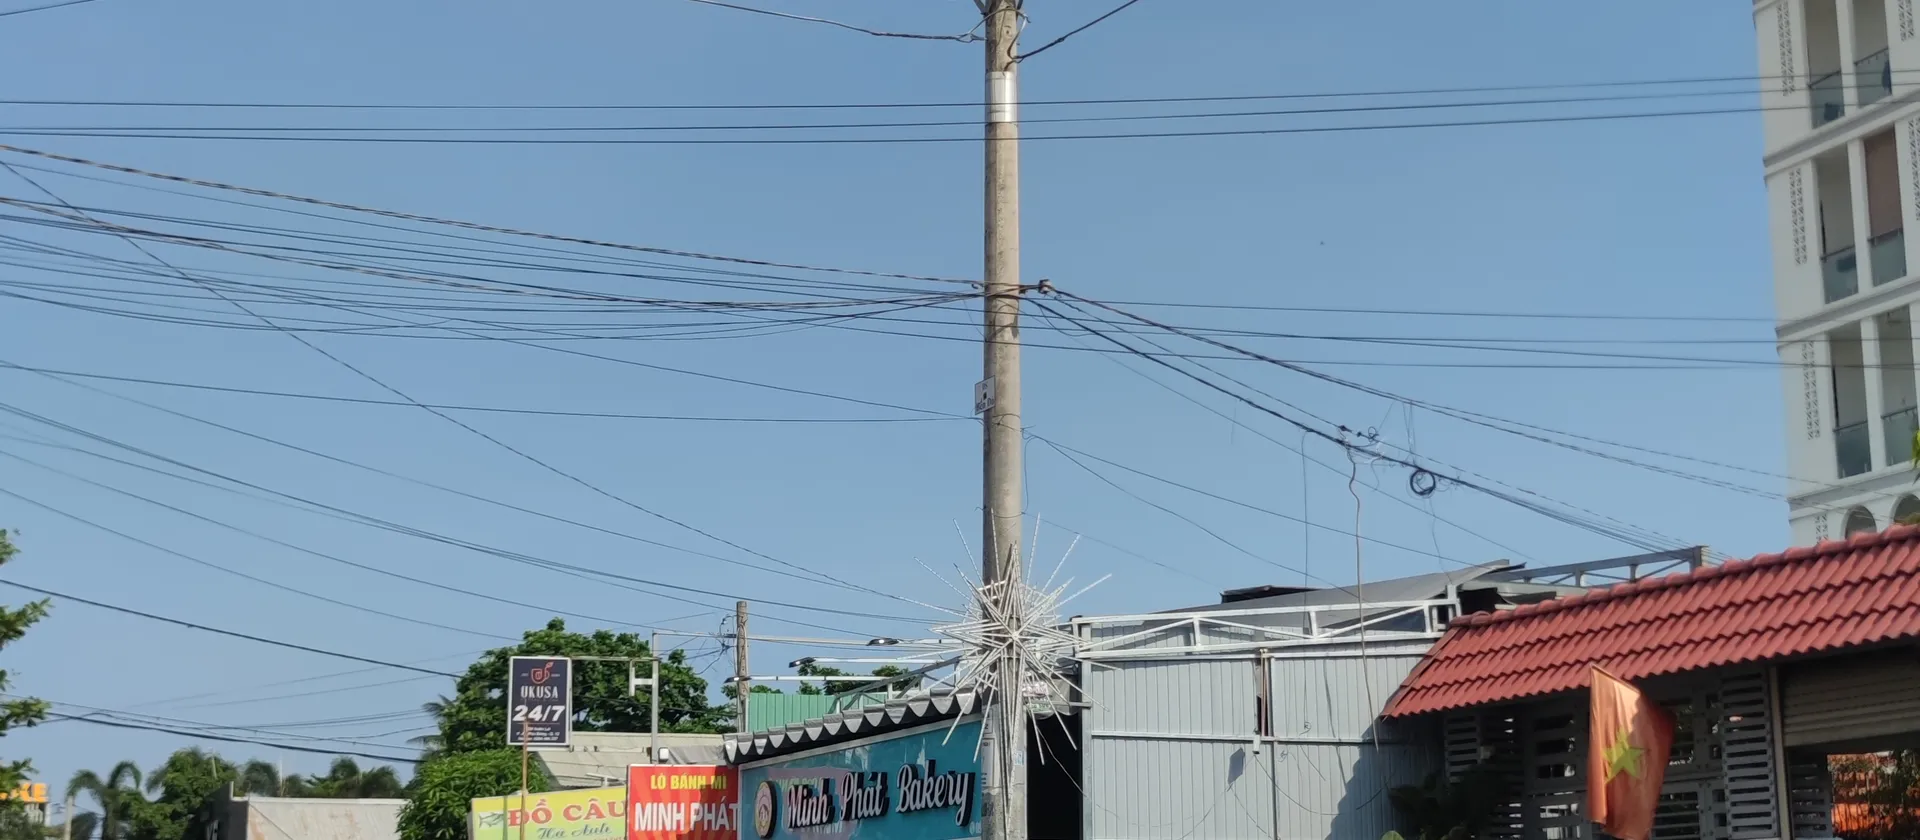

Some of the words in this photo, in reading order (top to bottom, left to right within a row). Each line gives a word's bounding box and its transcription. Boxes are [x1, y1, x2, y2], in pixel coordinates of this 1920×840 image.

[520, 686, 559, 699] UKUSA
[512, 704, 566, 722] 24/7
[670, 772, 706, 790] BÁNH
[787, 777, 830, 828] Minh
[841, 771, 884, 820] Phát
[896, 763, 969, 826] Bakery
[508, 798, 552, 826] ĐỒ
[635, 802, 685, 831] MINH
[690, 795, 739, 831] PHÁT
